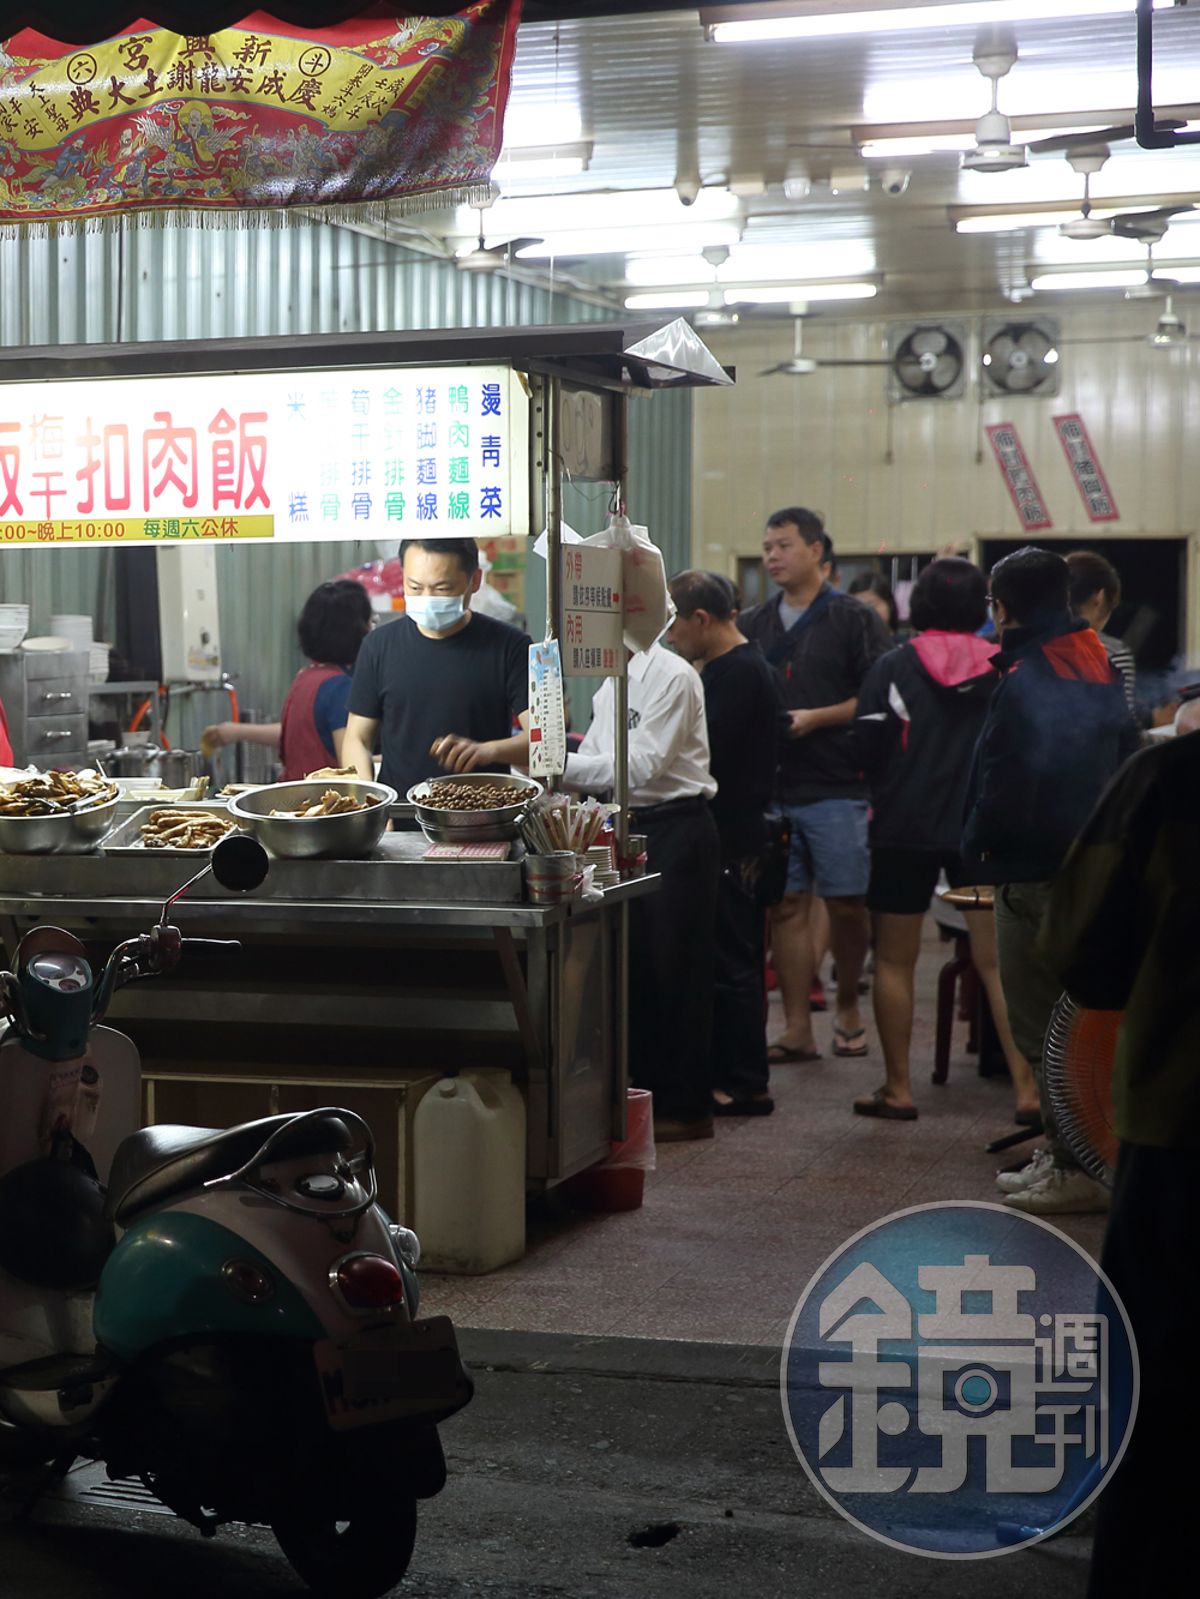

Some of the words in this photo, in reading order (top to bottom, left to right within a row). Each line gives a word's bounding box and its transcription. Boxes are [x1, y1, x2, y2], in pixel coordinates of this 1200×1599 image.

[143, 518, 239, 539] 每週六公休
